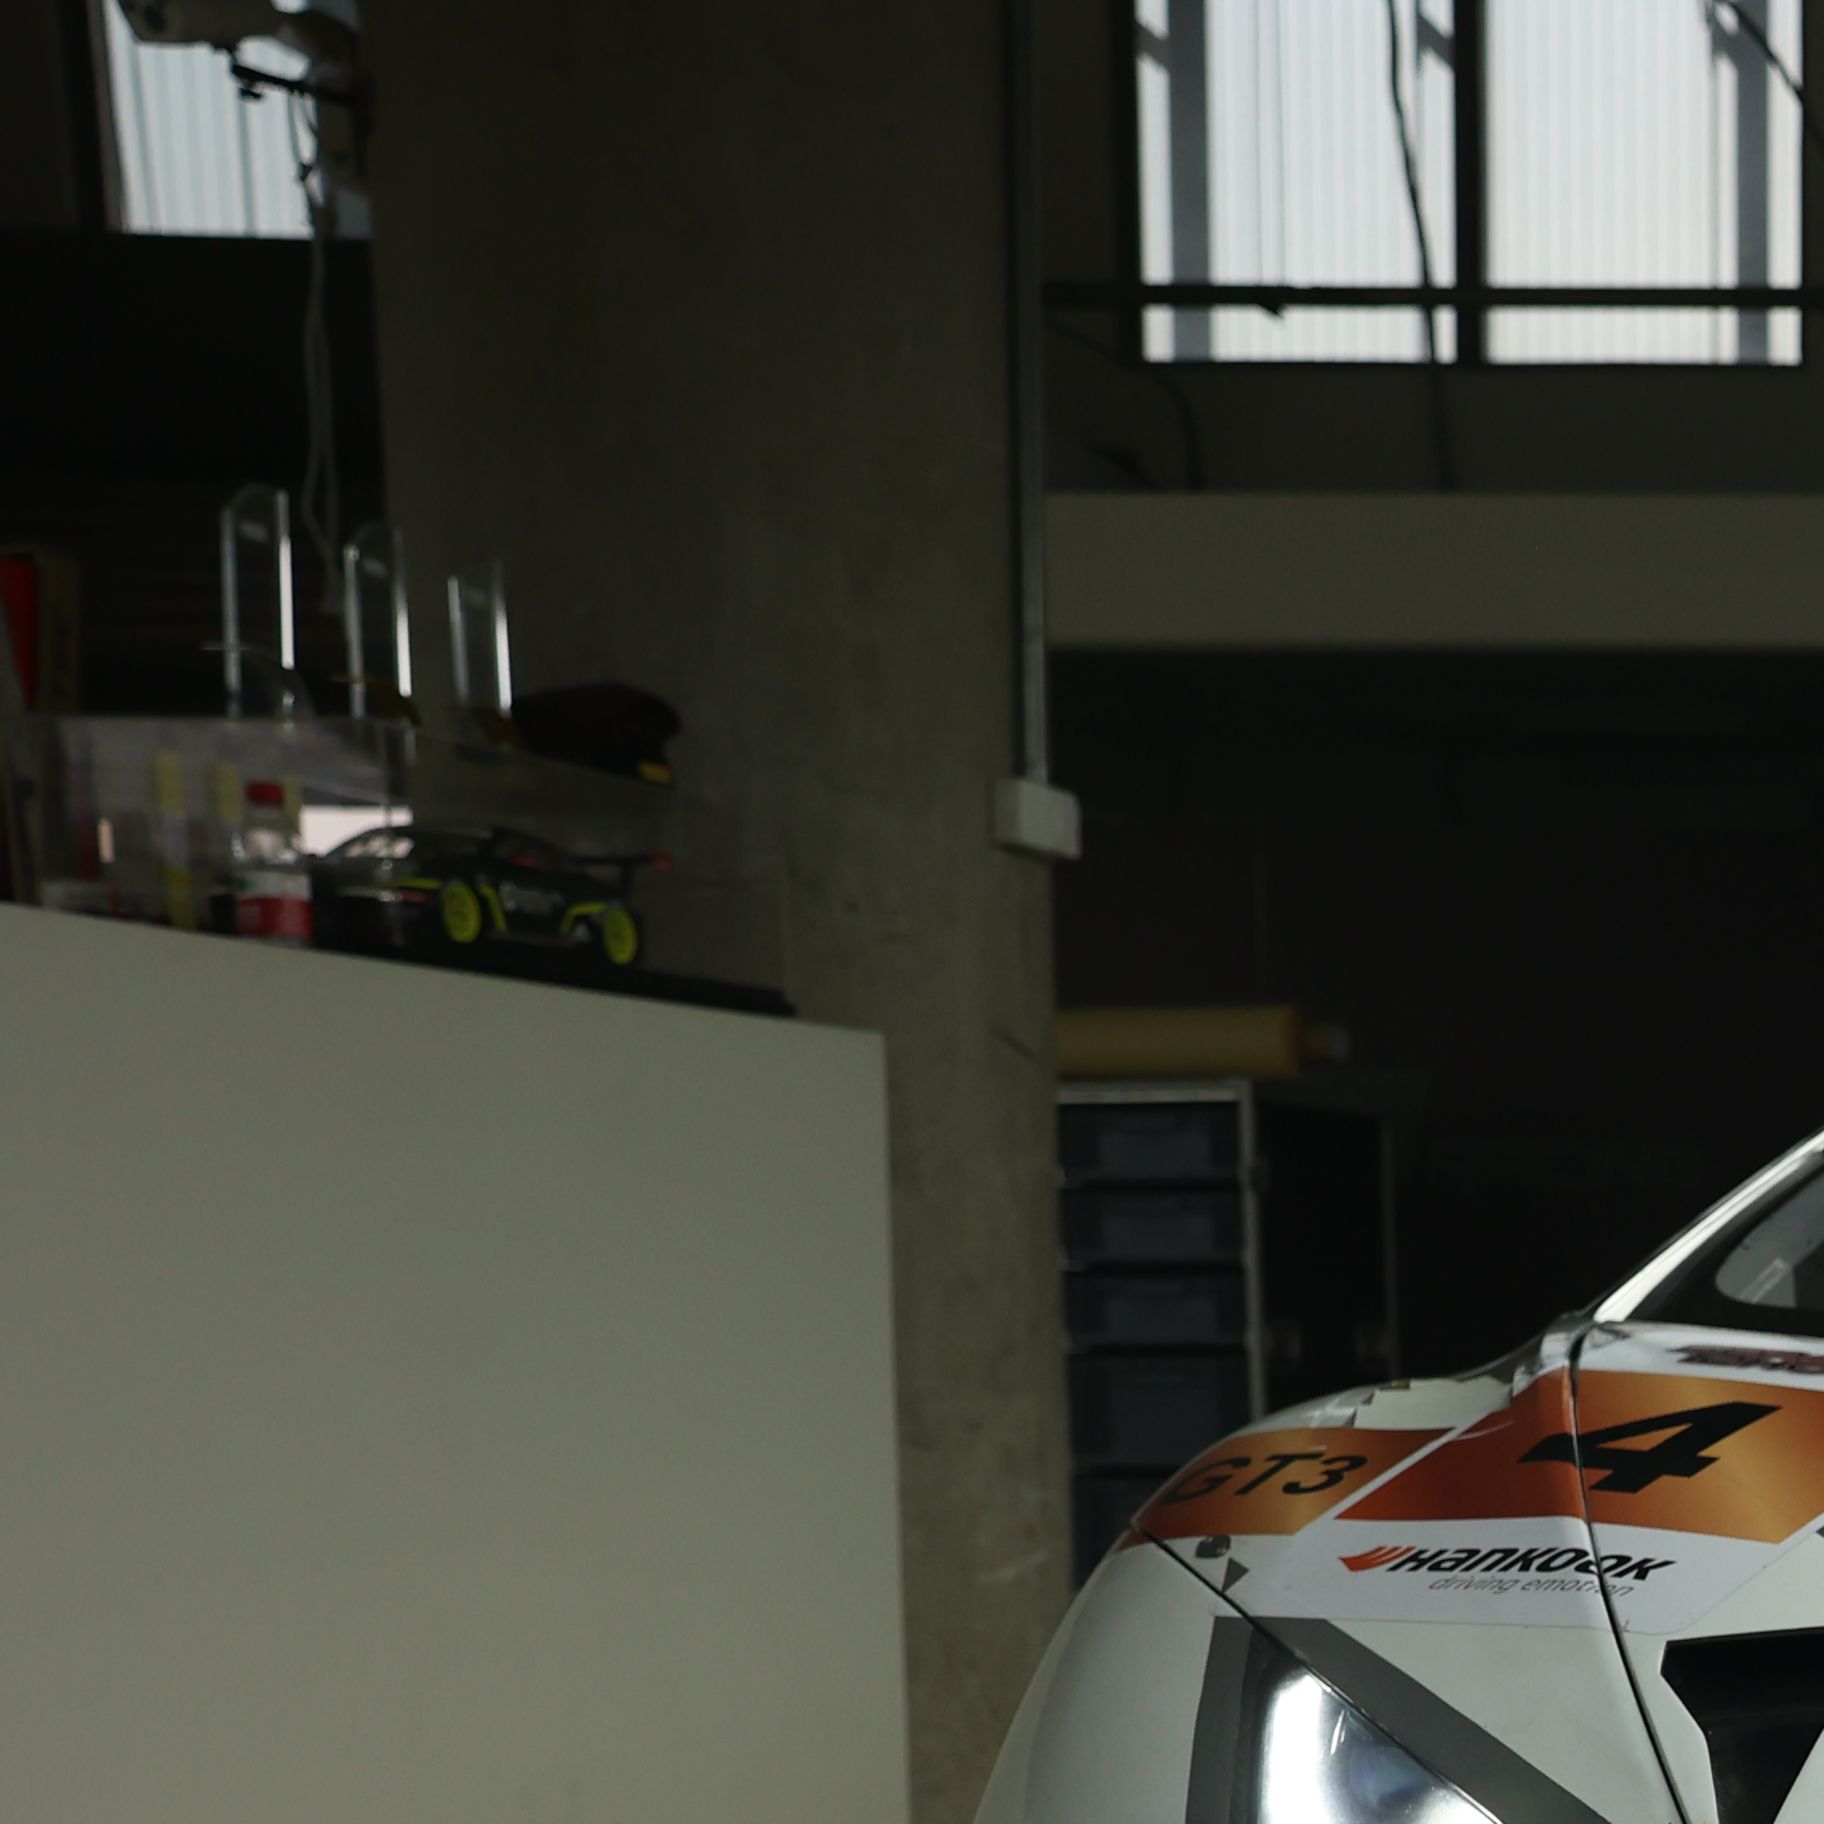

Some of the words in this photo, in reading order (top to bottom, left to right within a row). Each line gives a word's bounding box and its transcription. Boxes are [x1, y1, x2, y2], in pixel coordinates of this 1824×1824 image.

[1516, 1401, 1783, 1494] 4
[1165, 1452, 1368, 1503] GT3
[1428, 1575, 1512, 1595] driving
